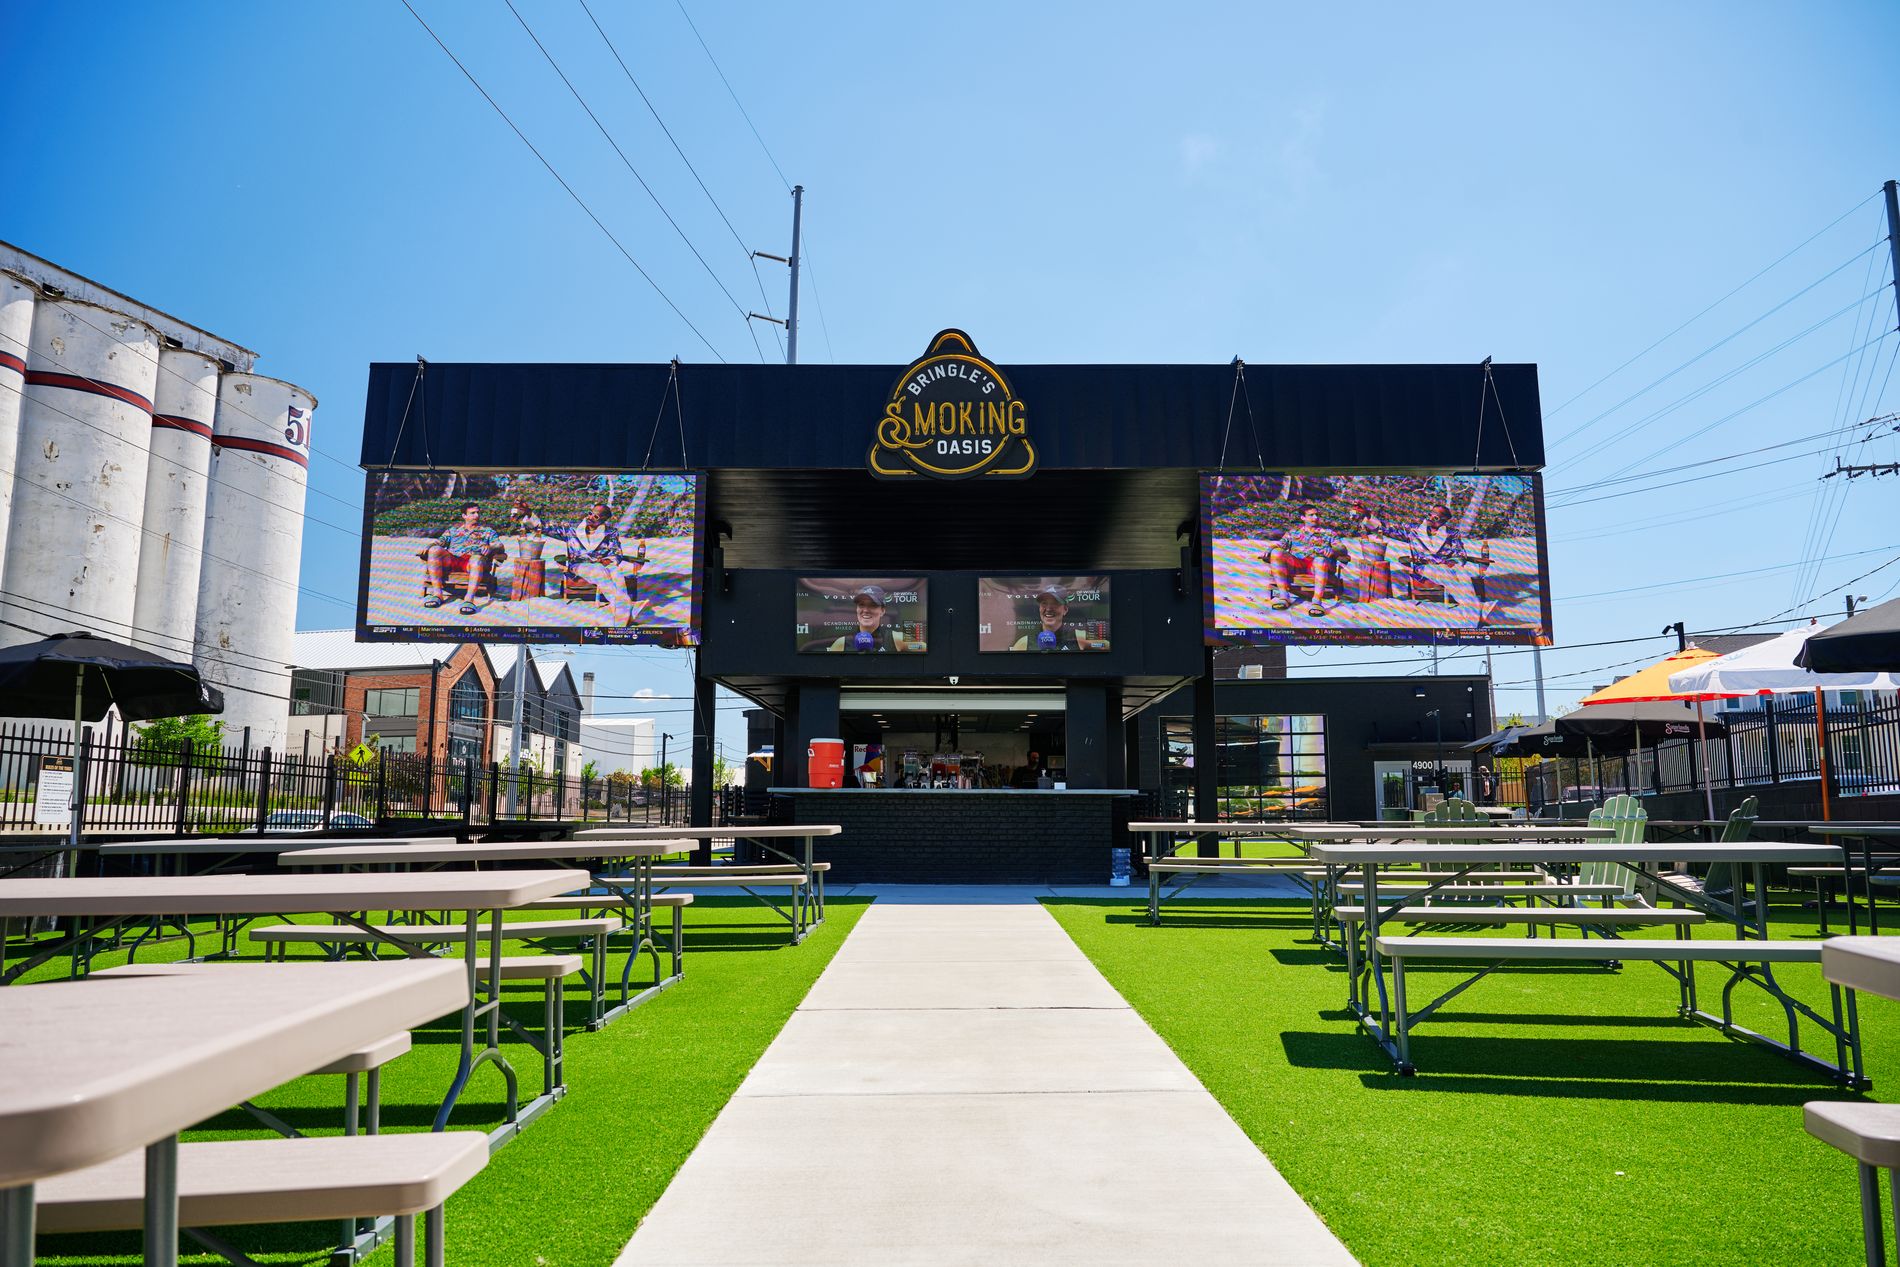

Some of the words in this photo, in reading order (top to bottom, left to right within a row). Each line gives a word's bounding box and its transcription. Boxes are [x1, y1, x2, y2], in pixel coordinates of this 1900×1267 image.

[907, 364, 996, 396] BRINGLE'S
[877, 395, 1026, 449] SMOKING
[937, 439, 992, 455] OASIS
[1077, 593, 1100, 601] TOUR
[1412, 761, 1433, 770] 4900
